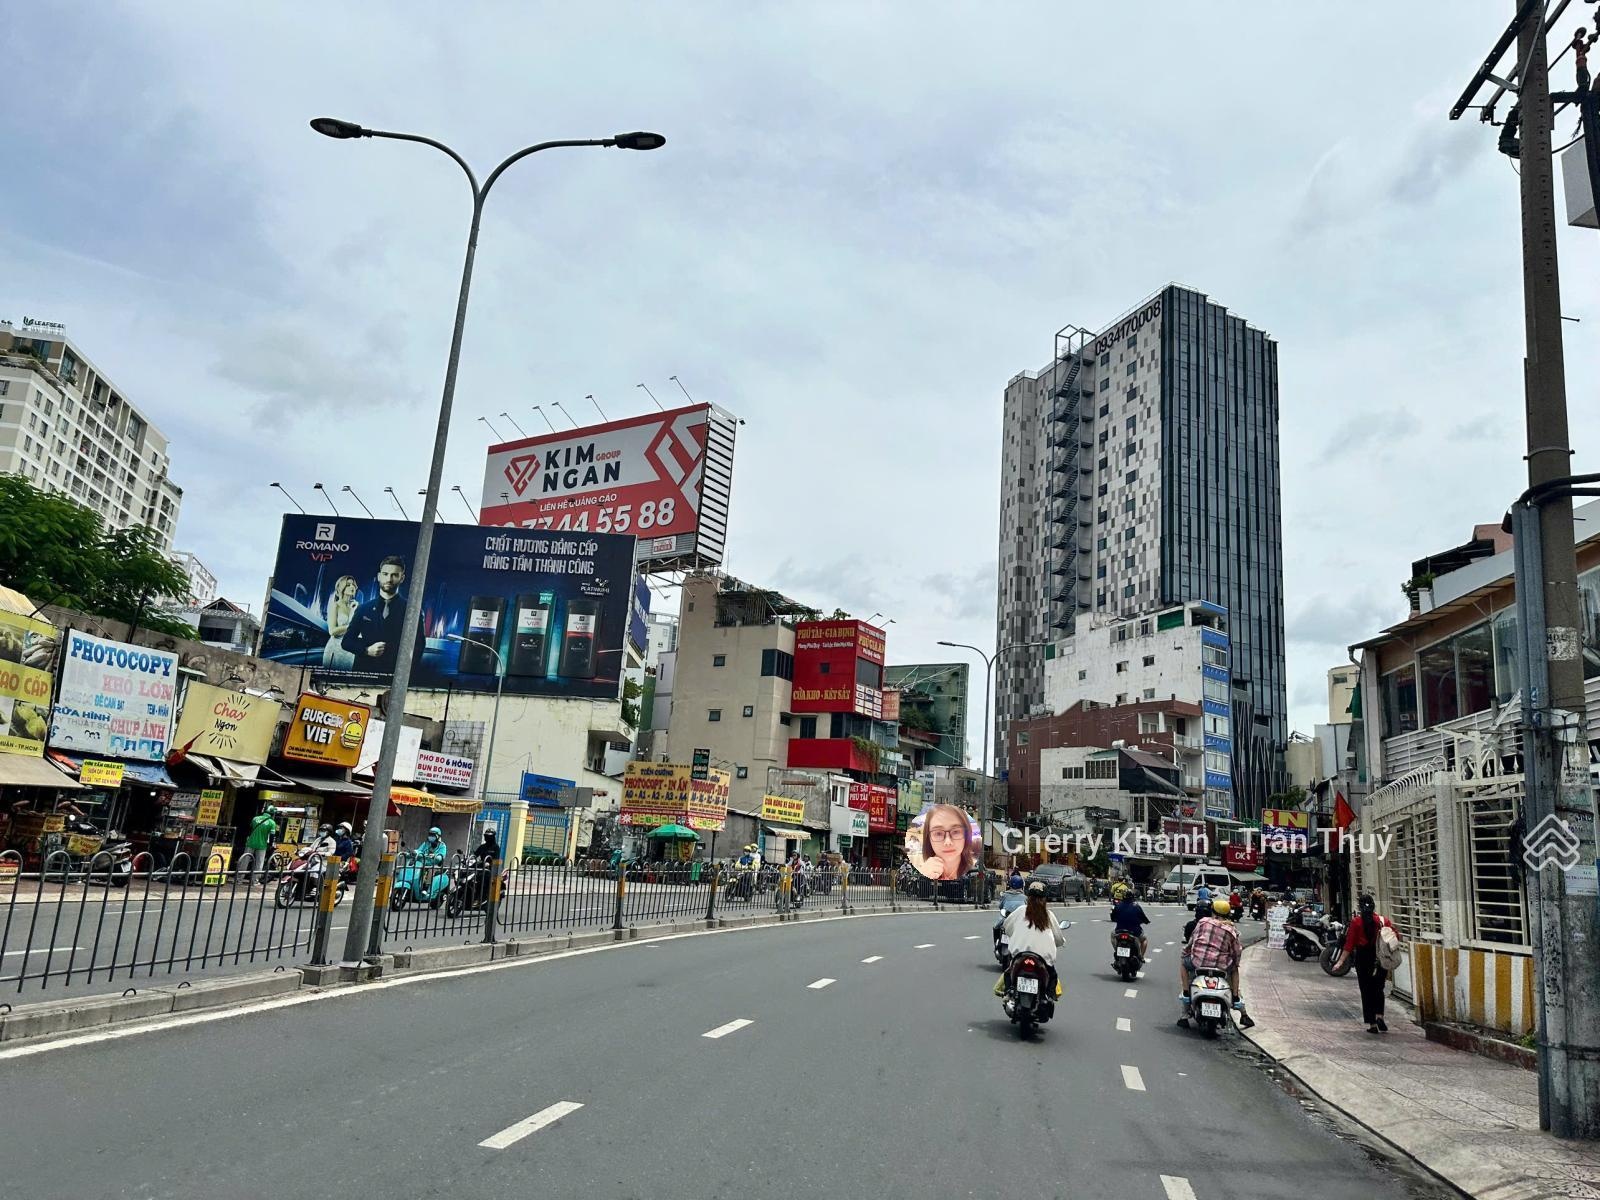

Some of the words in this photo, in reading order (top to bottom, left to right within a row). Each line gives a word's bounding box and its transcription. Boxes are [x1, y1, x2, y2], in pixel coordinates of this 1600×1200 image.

[1095, 300, 1161, 357] 0934170008
[545, 443, 595, 471] KIM
[595, 450, 621, 462] GROUP
[542, 461, 621, 493] NGAN
[596, 504, 632, 534] 55
[637, 497, 675, 529] 88
[295, 540, 350, 553] ROMANO
[311, 552, 334, 562] VIP
[70, 637, 174, 677] PHOTOCOPY
[213, 702, 247, 721] Chay
[301, 707, 344, 728] BURGER
[305, 724, 336, 744] VIET
